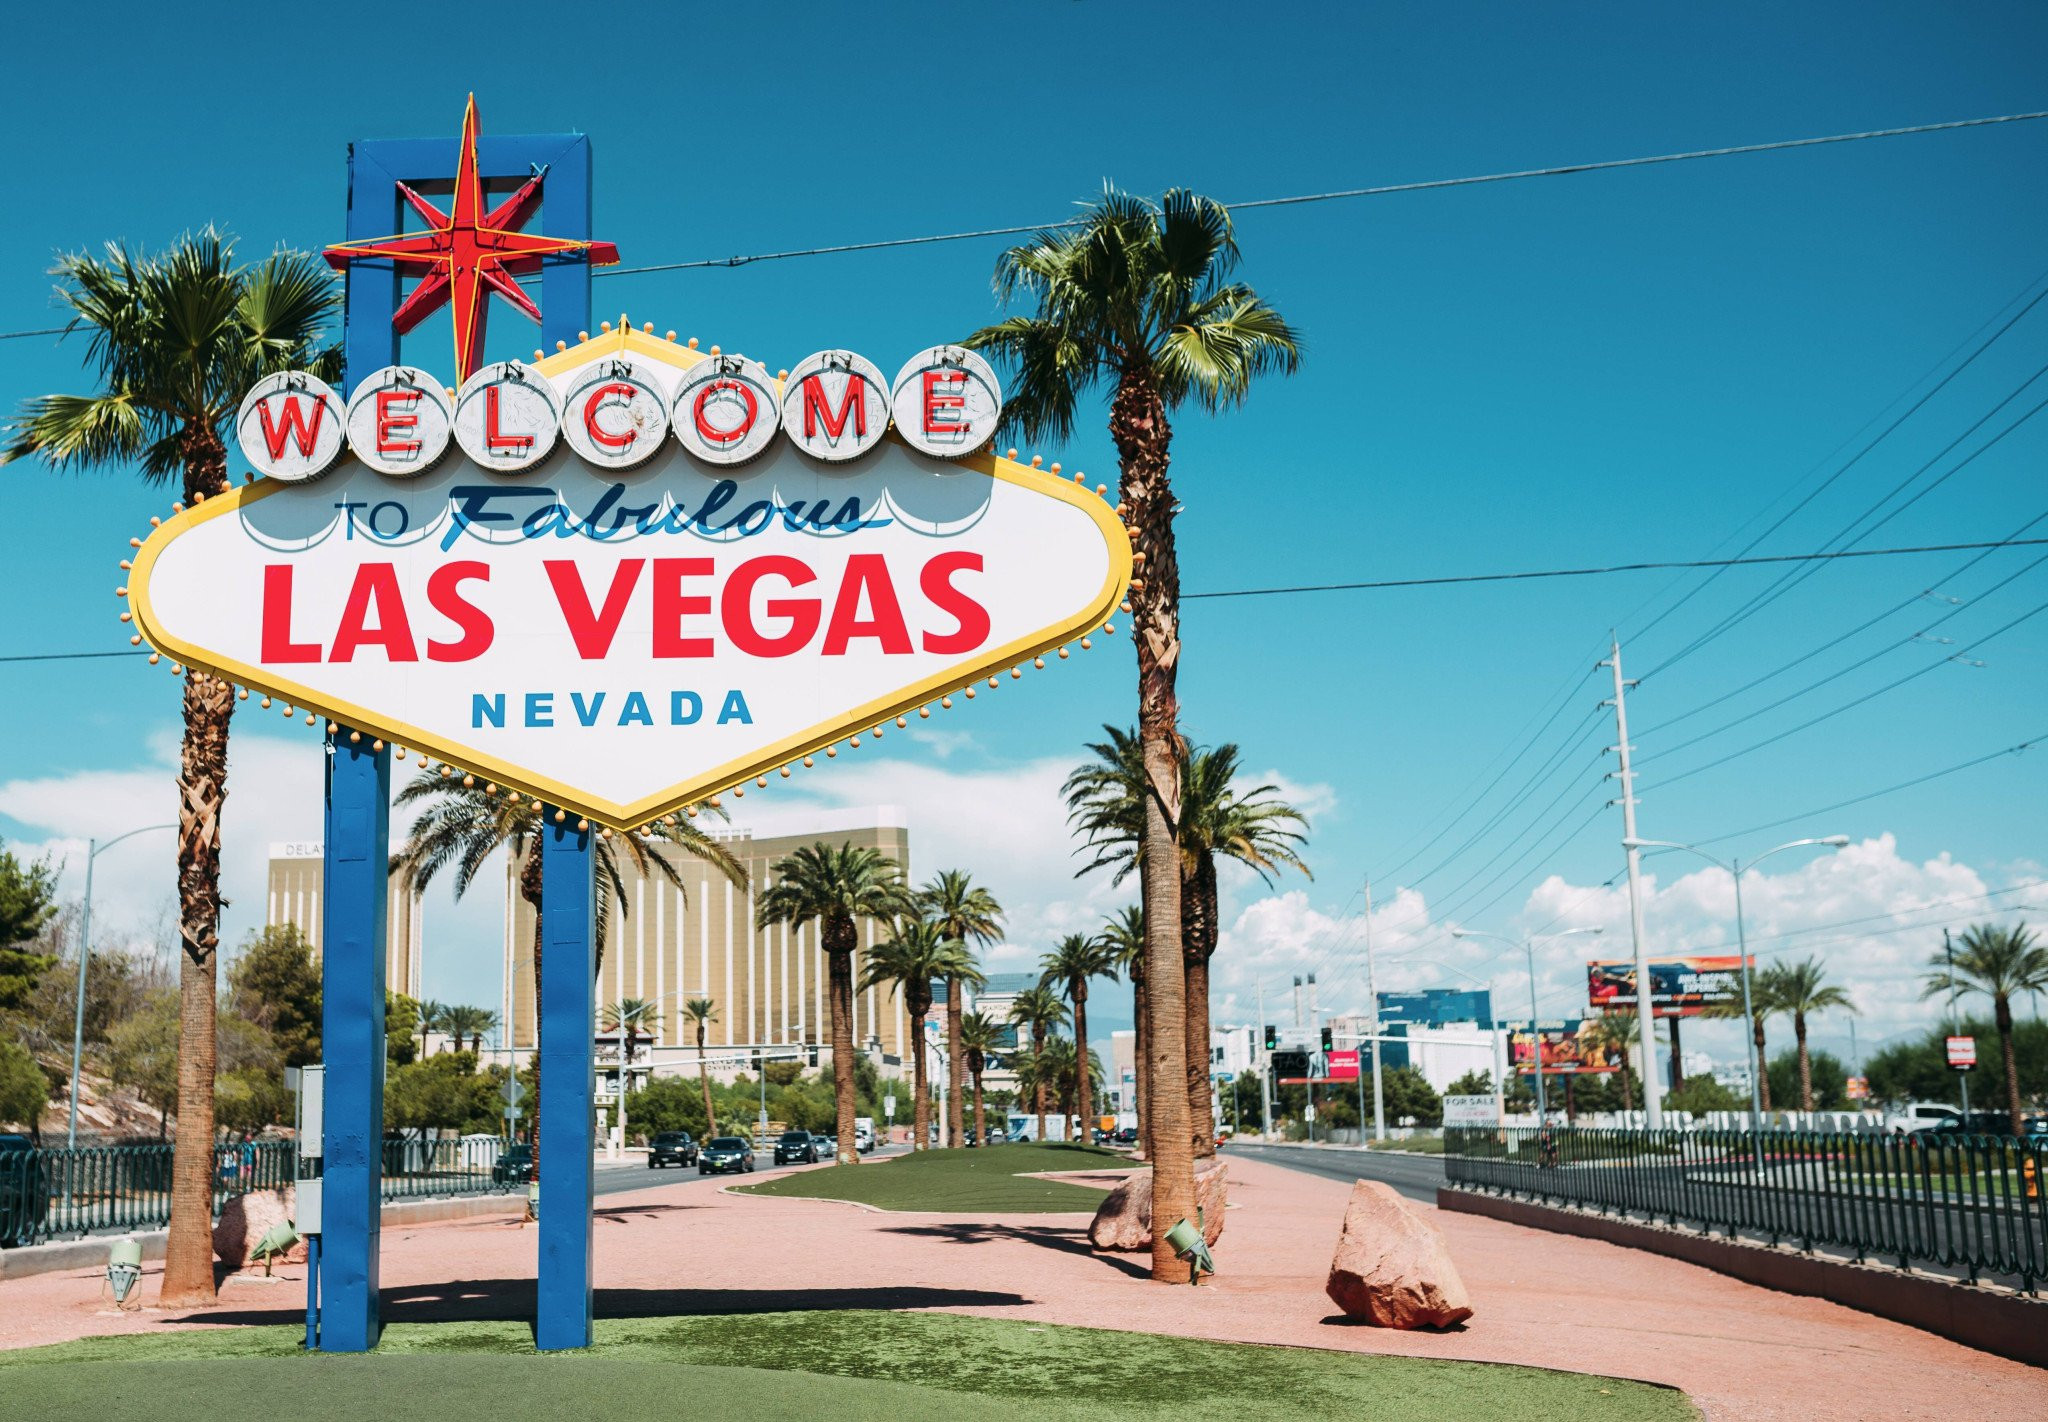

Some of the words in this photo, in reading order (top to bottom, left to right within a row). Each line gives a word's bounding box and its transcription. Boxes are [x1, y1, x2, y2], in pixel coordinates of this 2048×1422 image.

[256, 371, 968, 460] WELCOME
[334, 501, 409, 541] TO
[439, 478, 895, 553] Fabulous
[260, 558, 496, 665] LAS
[543, 551, 992, 660] VEGAS
[471, 690, 754, 729] NEVADA
[286, 844, 323, 856] DELA
